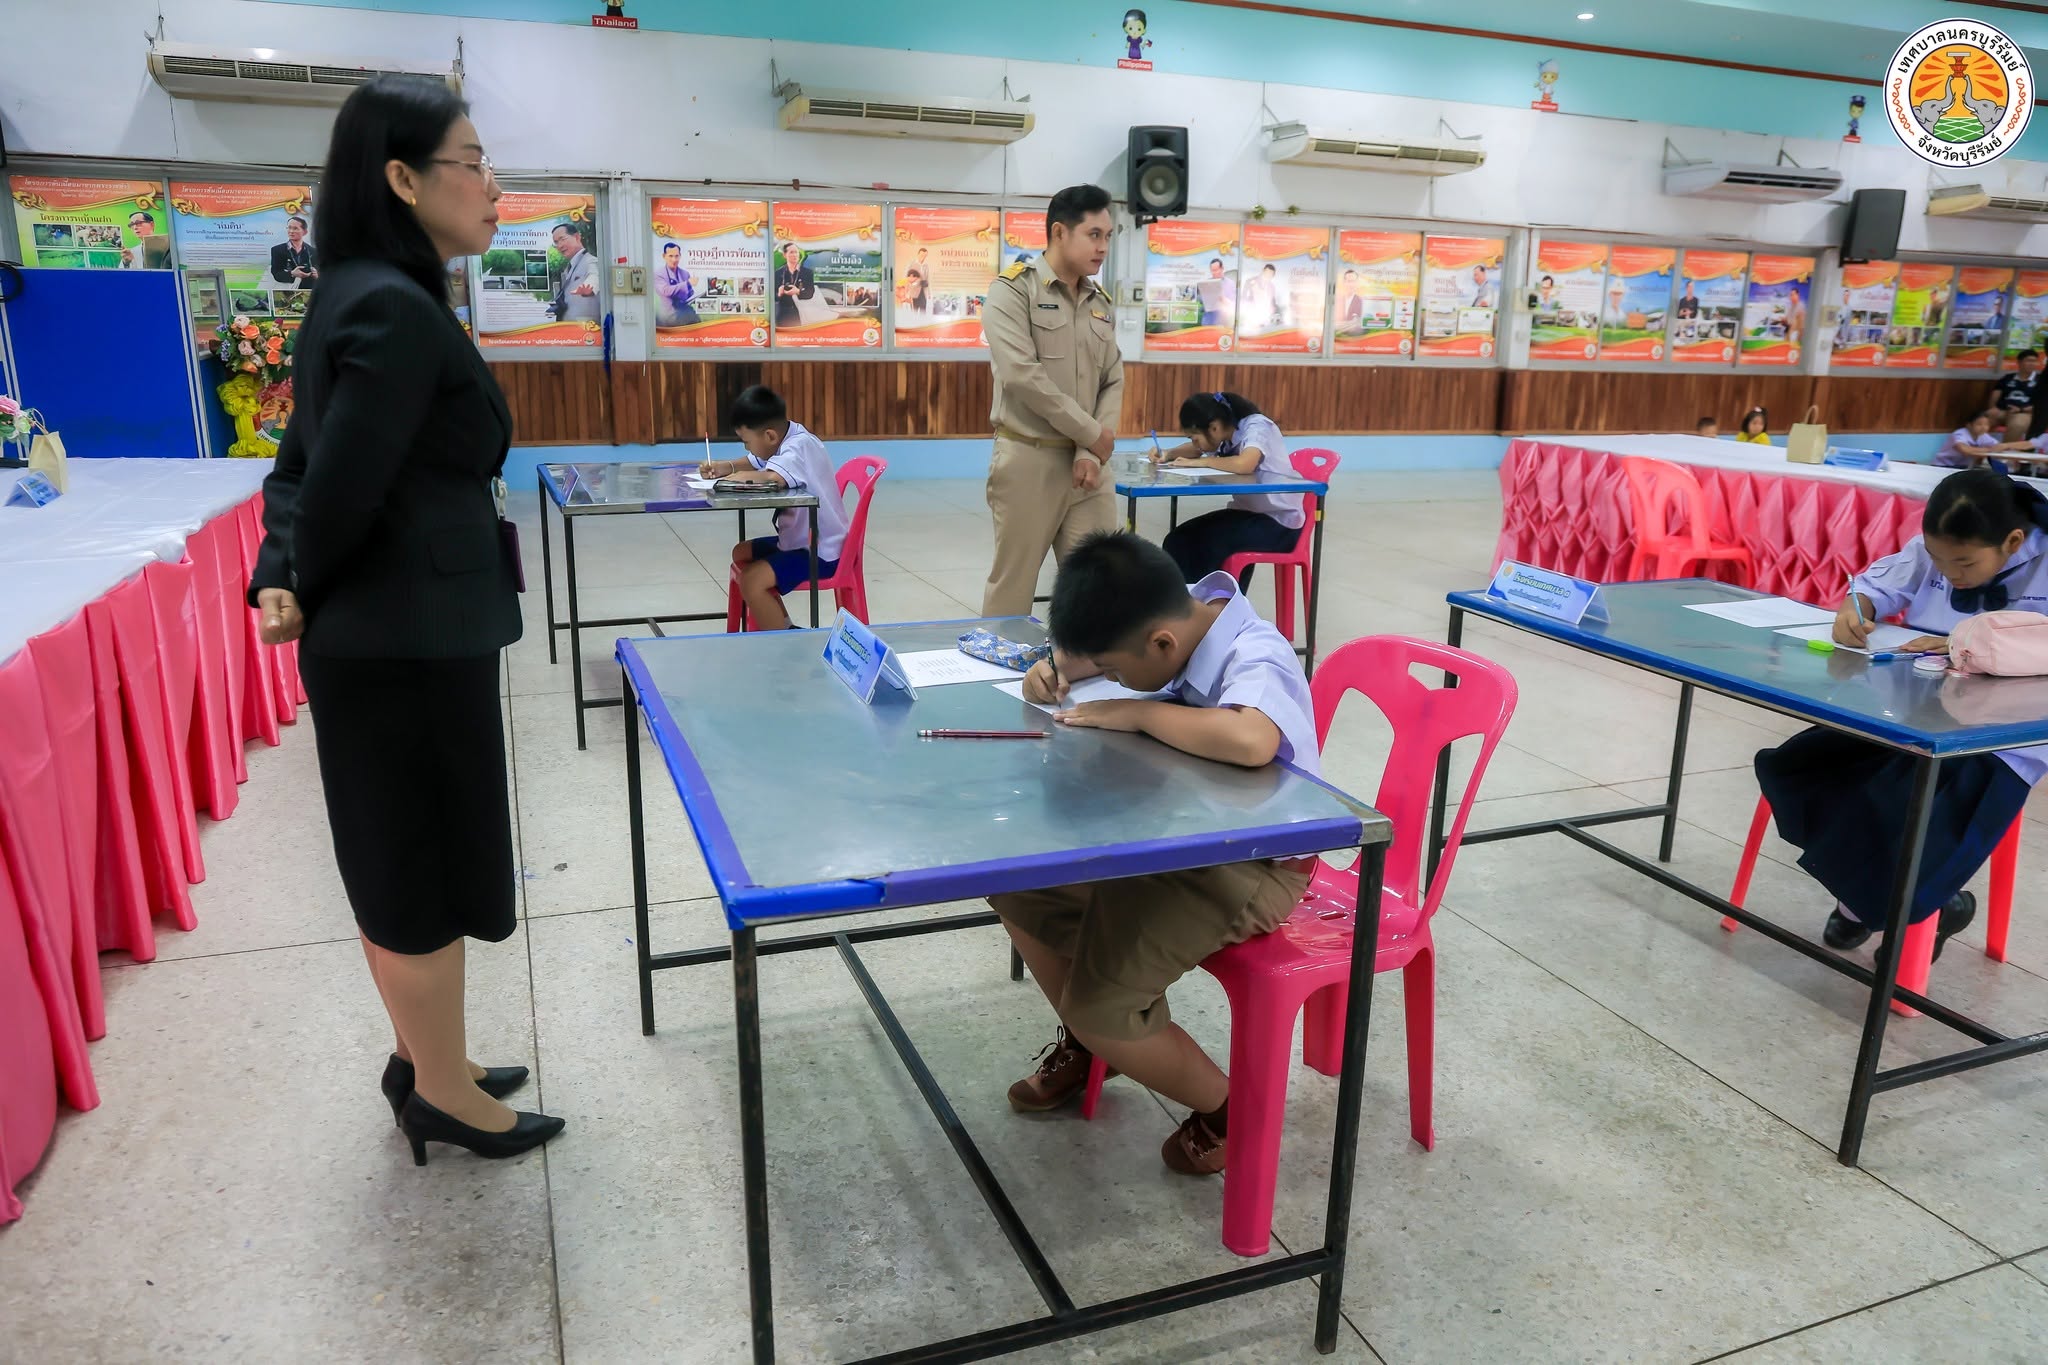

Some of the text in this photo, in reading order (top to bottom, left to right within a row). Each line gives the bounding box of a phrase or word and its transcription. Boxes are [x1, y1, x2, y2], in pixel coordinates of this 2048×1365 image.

[594, 17, 636, 28] Thailand
[40, 213, 112, 224] โครงการหญ้าแฝก
[687, 247, 766, 260] ทฤษฎีการพัฒนา
[830, 253, 863, 265] แก้มลิง
